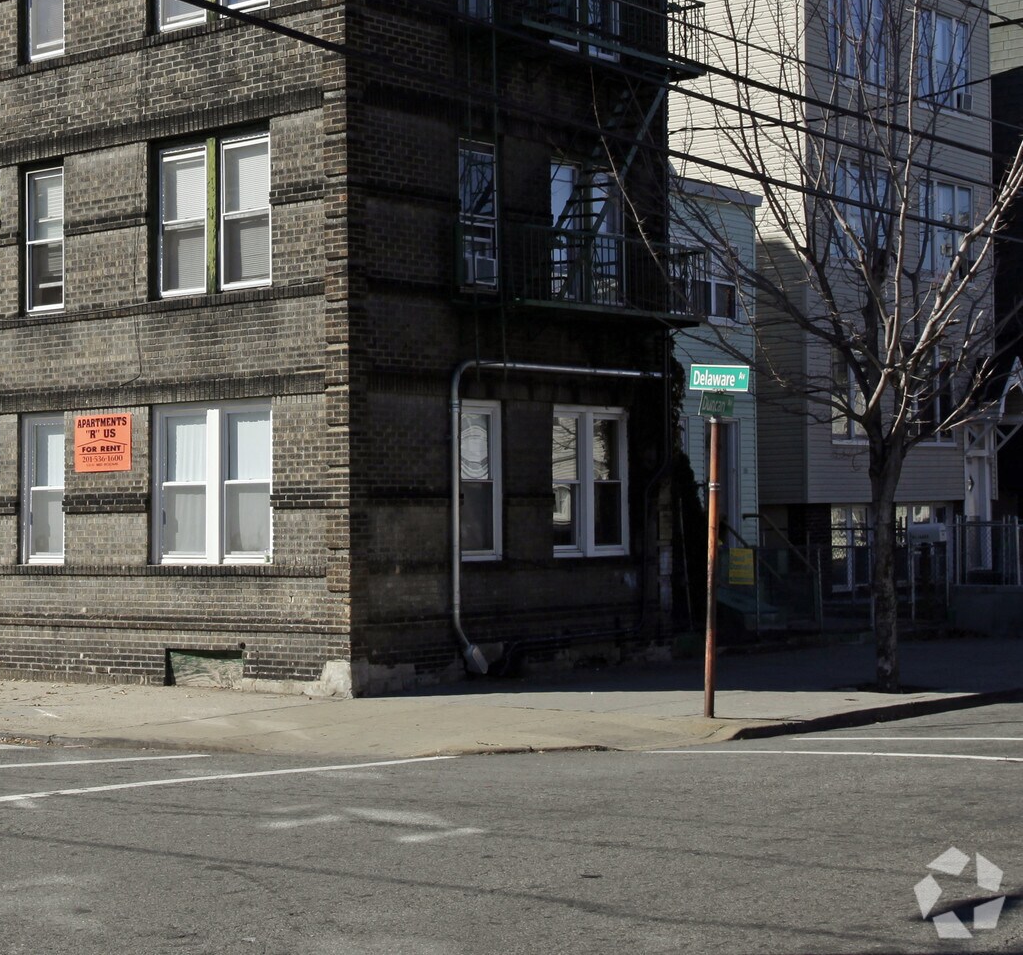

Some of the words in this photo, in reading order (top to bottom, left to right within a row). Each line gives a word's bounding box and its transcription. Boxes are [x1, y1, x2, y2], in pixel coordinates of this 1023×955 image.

[693, 369, 736, 387] Delaware
[738, 371, 746, 381] Av
[77, 416, 127, 429] APARTMENTS
[86, 429, 100, 439] "R"
[103, 429, 116, 438] US
[82, 445, 97, 453] FOR
[100, 444, 121, 452] RENT
